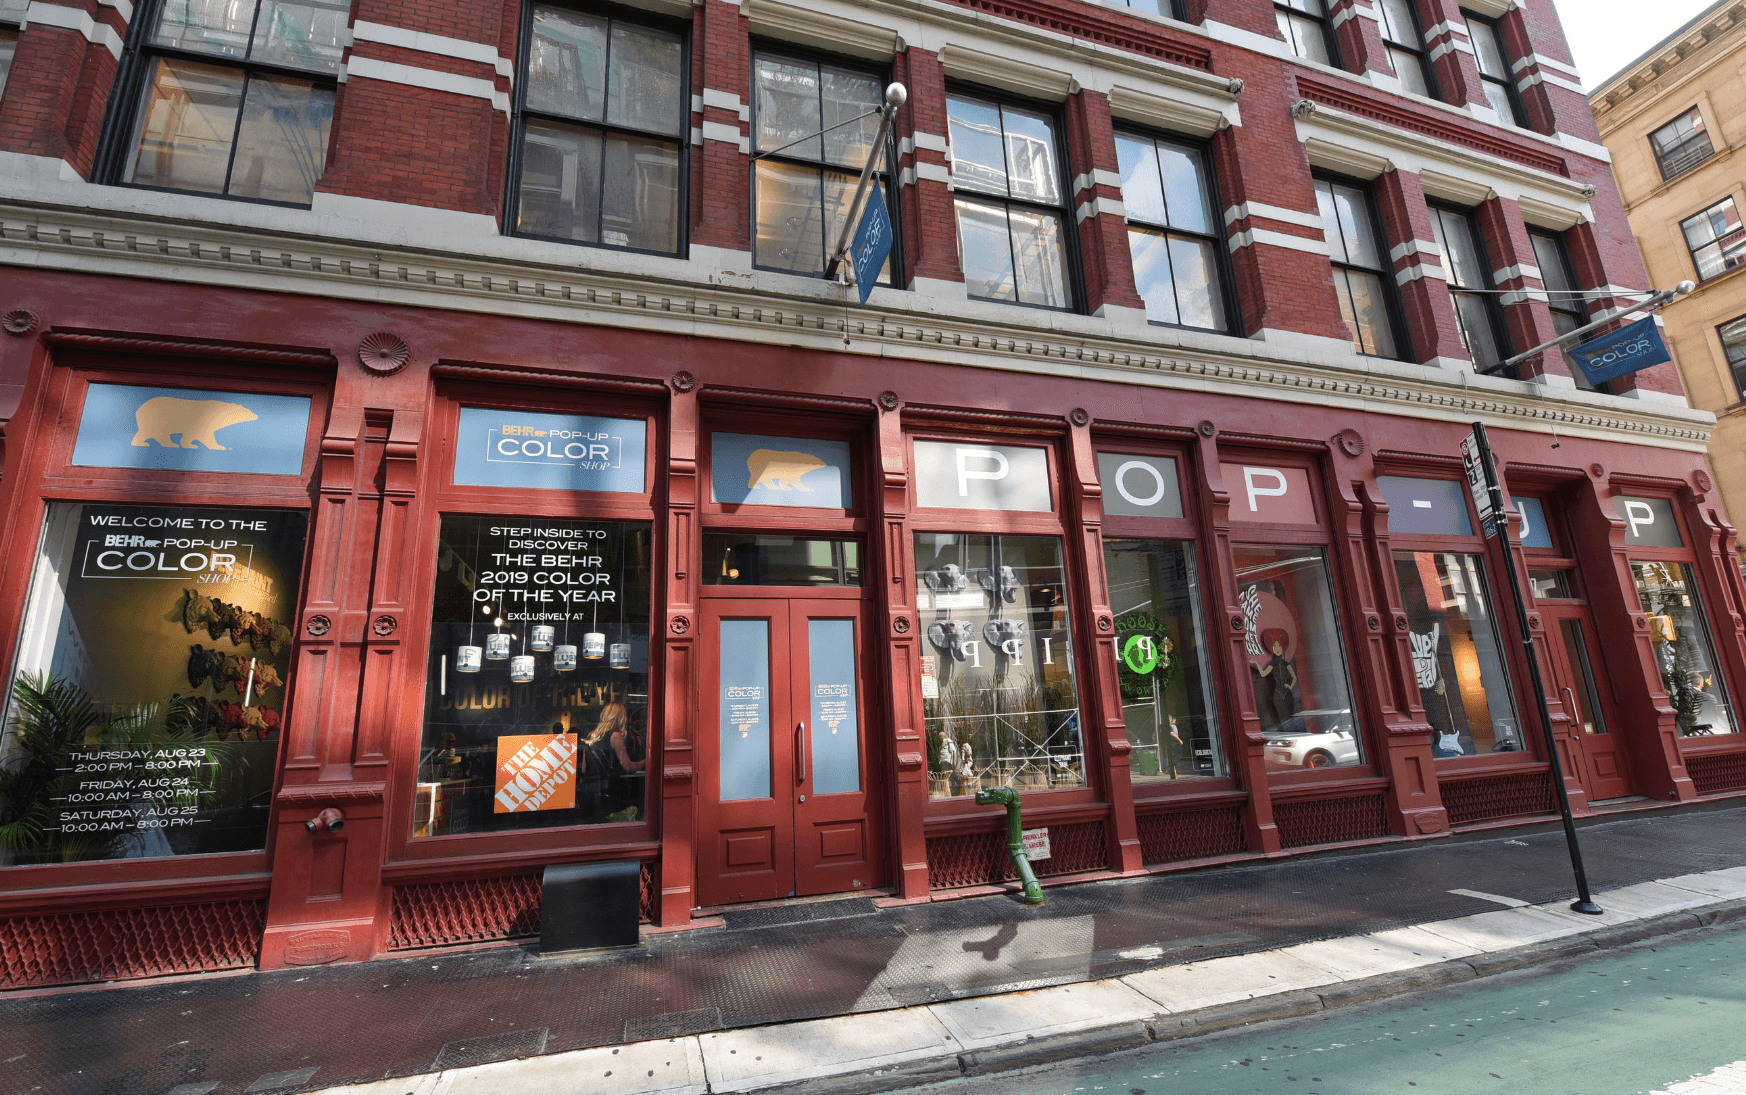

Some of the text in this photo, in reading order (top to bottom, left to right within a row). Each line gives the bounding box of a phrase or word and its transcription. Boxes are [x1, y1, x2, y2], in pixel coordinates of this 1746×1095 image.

[858, 217, 880, 272] COLOR
[1589, 339, 1651, 367] COLOR
[502, 424, 609, 441] BEHR POP-UP
[497, 438, 609, 460] COLOR
[579, 460, 611, 471] SHOP
[91, 515, 268, 531] WELCOME TO THE
[490, 527, 607, 539] STEP INSIDE TO
[105, 534, 238, 550] BEHR POP-UP
[509, 539, 588, 550] DISCOVER
[96, 550, 237, 572] COLOR
[492, 553, 602, 568] THE BEHR
[480, 571, 610, 585] 2019 COLOR
[473, 589, 616, 603] OF THE YEAR
[507, 612, 584, 621] EXCLUSIVELY AT
[69, 748, 206, 762] THURSDAY, AUG 23
[500, 740, 540, 777] THE
[74, 763, 107, 773] 2:00
[109, 762, 132, 771] PM
[144, 760, 176, 770] 8:00
[178, 759, 201, 768] PM
[495, 733, 577, 812] HOME
[79, 778, 189, 790] FRIDAY, AUG 24
[523, 759, 577, 812] DEPOT
[67, 793, 104, 802] 10:00
[106, 792, 130, 801] AM
[142, 790, 173, 799] 8:00
[176, 788, 199, 797] PM
[59, 806, 198, 821] SATURDAY, AUG 25
[61, 823, 98, 833] 10:00
[100, 822, 123, 831] AM
[136, 820, 168, 829] 8:00
[170, 818, 194, 827] PM
[1022, 832, 1047, 841] PRINKLER
